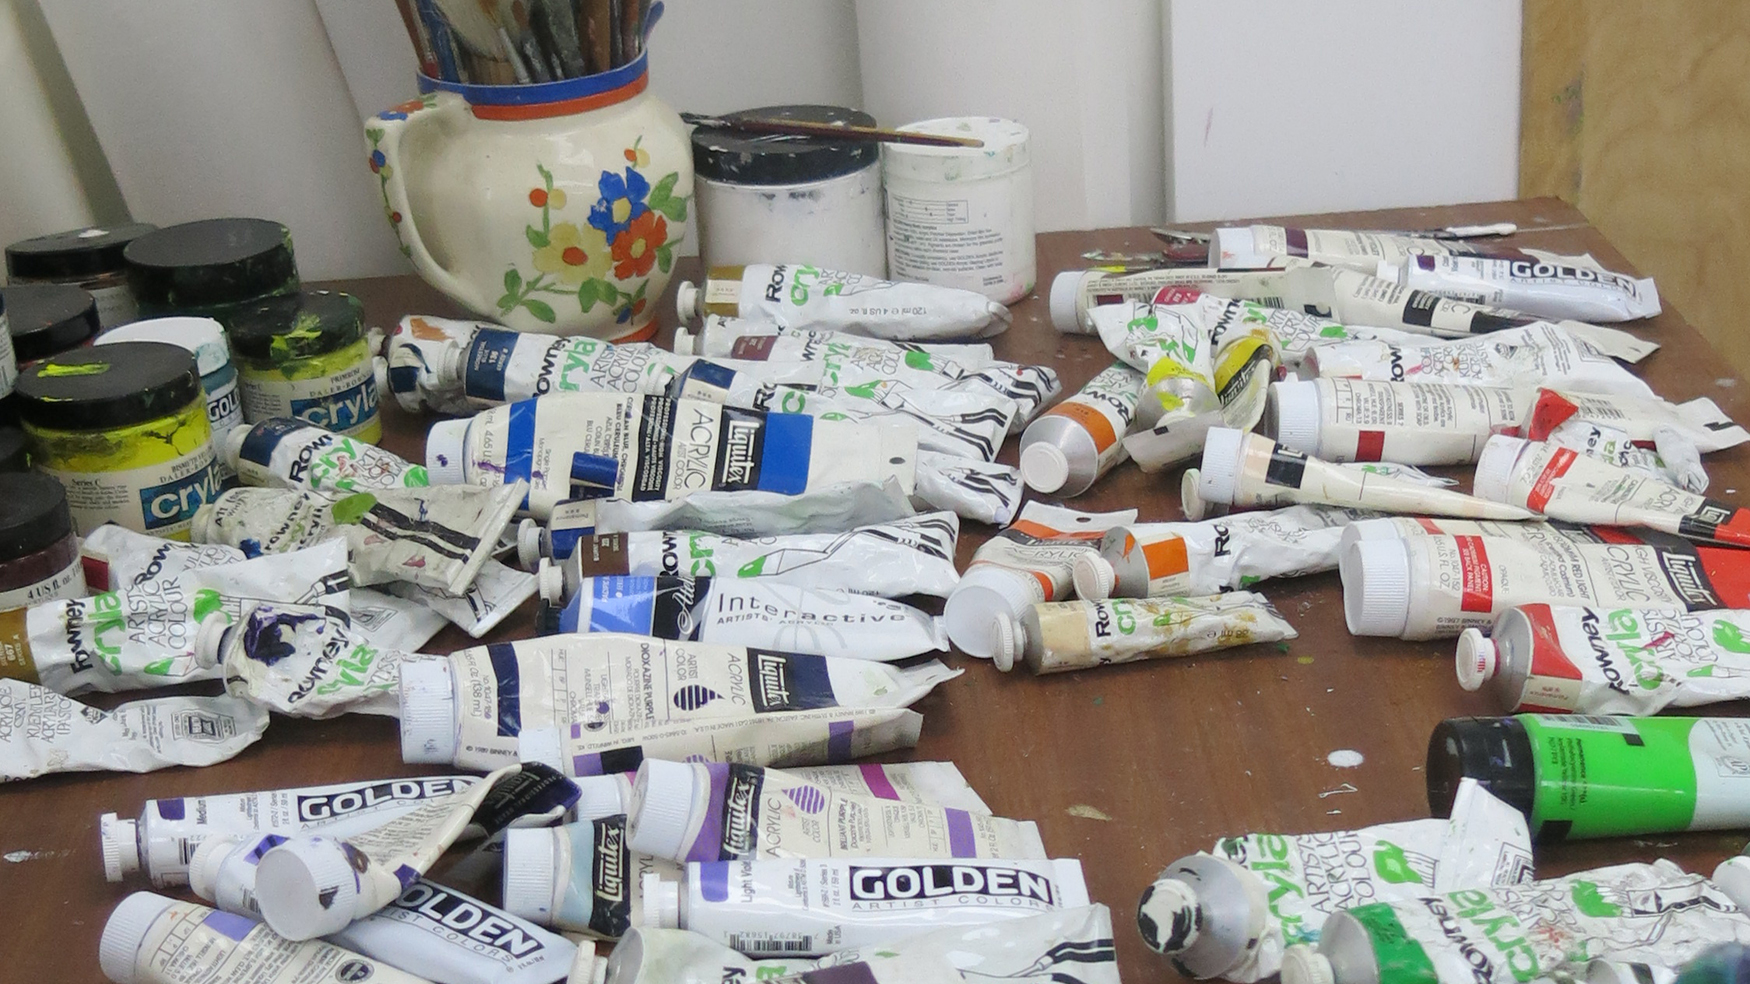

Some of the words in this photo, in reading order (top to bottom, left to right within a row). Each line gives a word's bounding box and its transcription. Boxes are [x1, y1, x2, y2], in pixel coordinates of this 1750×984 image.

[684, 408, 714, 489] ACRYLIC
[722, 420, 760, 484] Liquitex
[673, 460, 686, 490] COLOR
[163, 576, 188, 649] COLOUR
[719, 593, 905, 623] Interactive
[88, 591, 126, 676] cryla
[674, 648, 686, 681] COLOR
[687, 653, 698, 680] ARTIST
[727, 652, 746, 706] ACRYLIC
[723, 777, 754, 855] Liquitex
[766, 797, 782, 857] ACRYLIC
[812, 820, 821, 843] COLOR
[595, 822, 625, 901] Liquitex
[852, 866, 1051, 904] GOLDEN
[852, 899, 940, 911] ARTIST
[433, 926, 514, 963] COLORS
